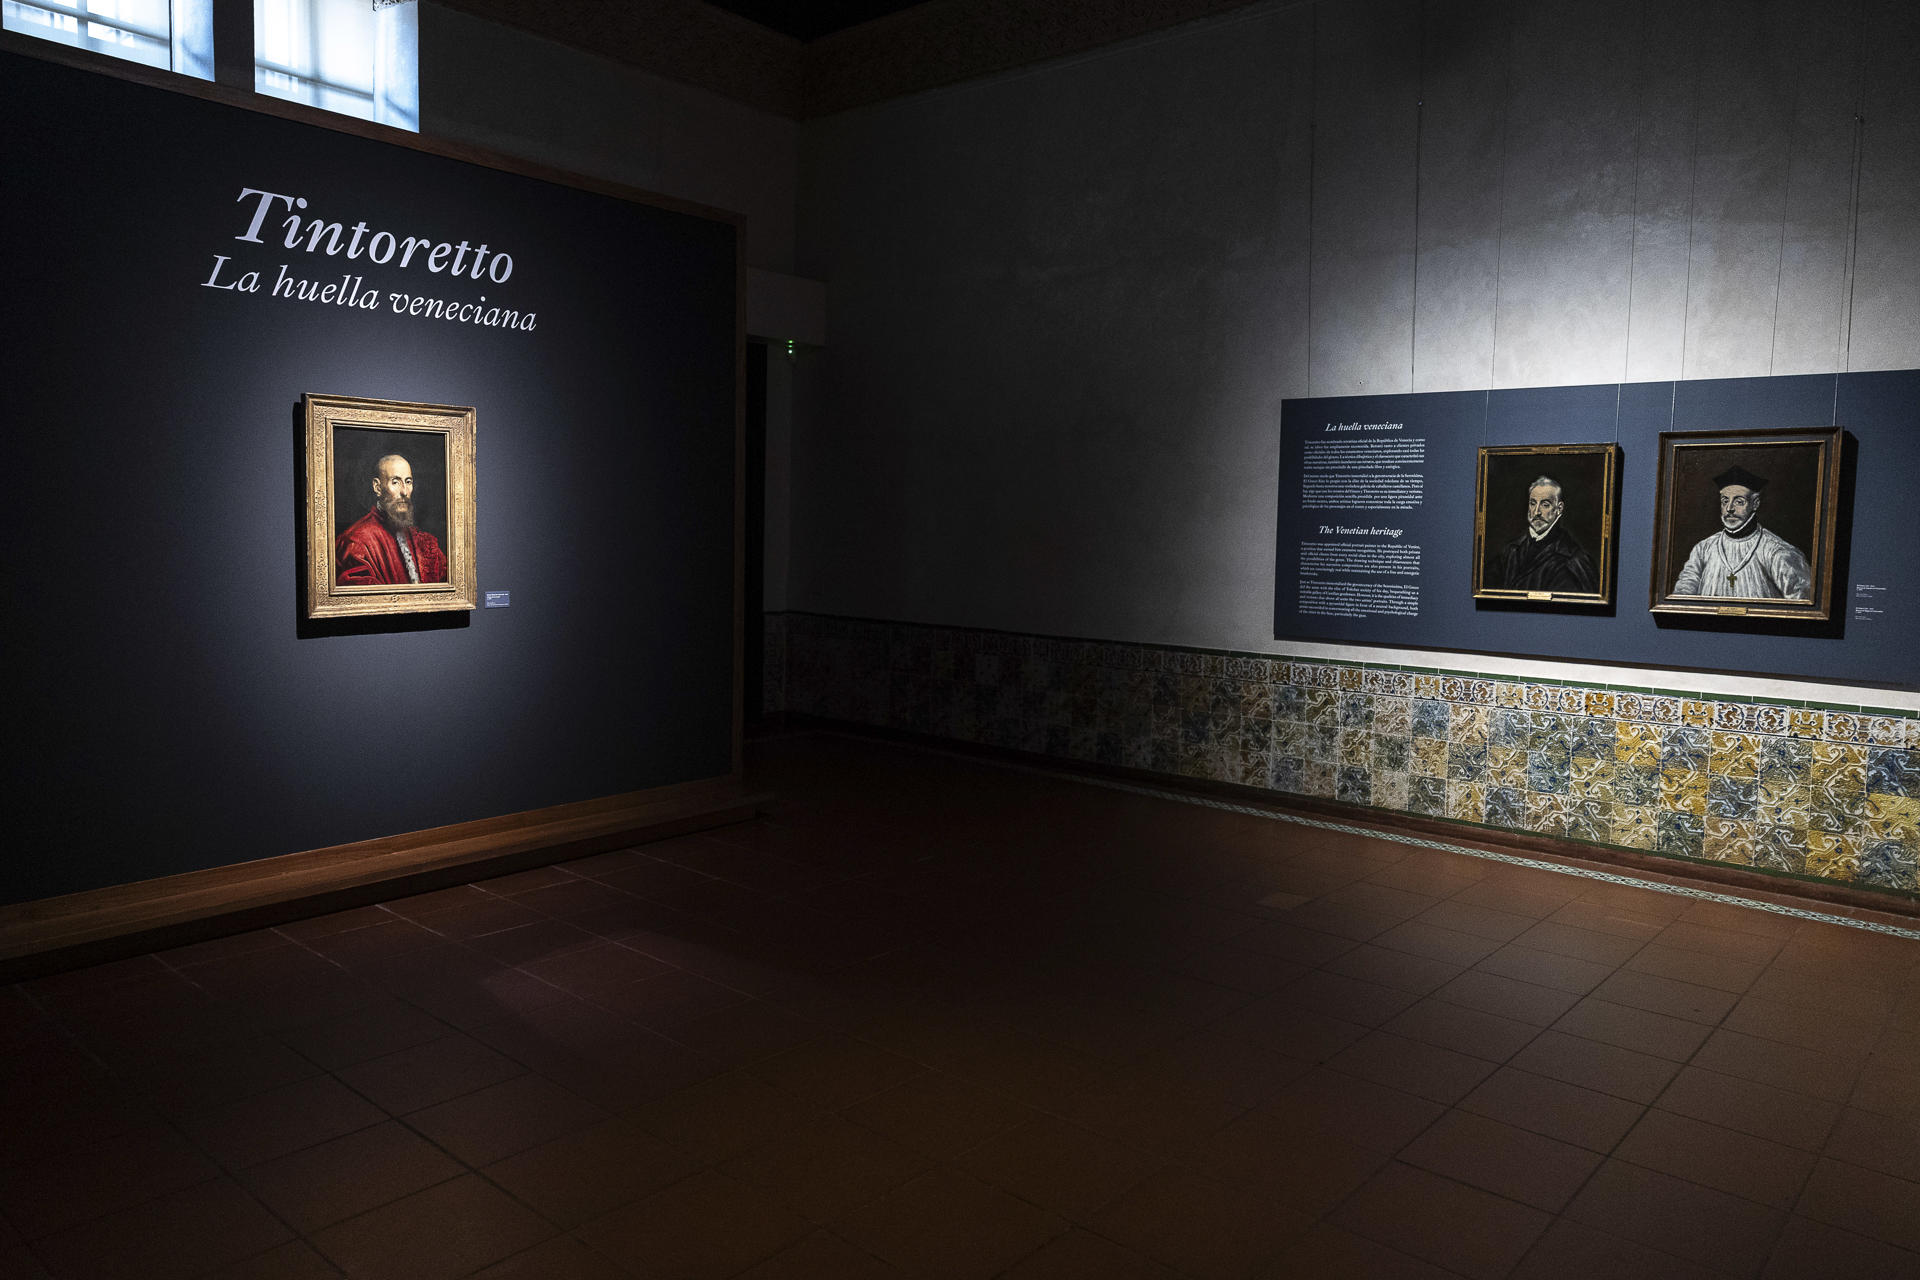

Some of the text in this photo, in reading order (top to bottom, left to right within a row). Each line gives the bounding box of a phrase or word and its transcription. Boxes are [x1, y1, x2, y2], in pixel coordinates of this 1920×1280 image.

[234, 187, 513, 284] Tintoretto
[200, 254, 537, 332] La huella veneciana
[1325, 421, 1404, 432] La huella veneciana
[1319, 525, 1404, 538] The Venetian heritage
